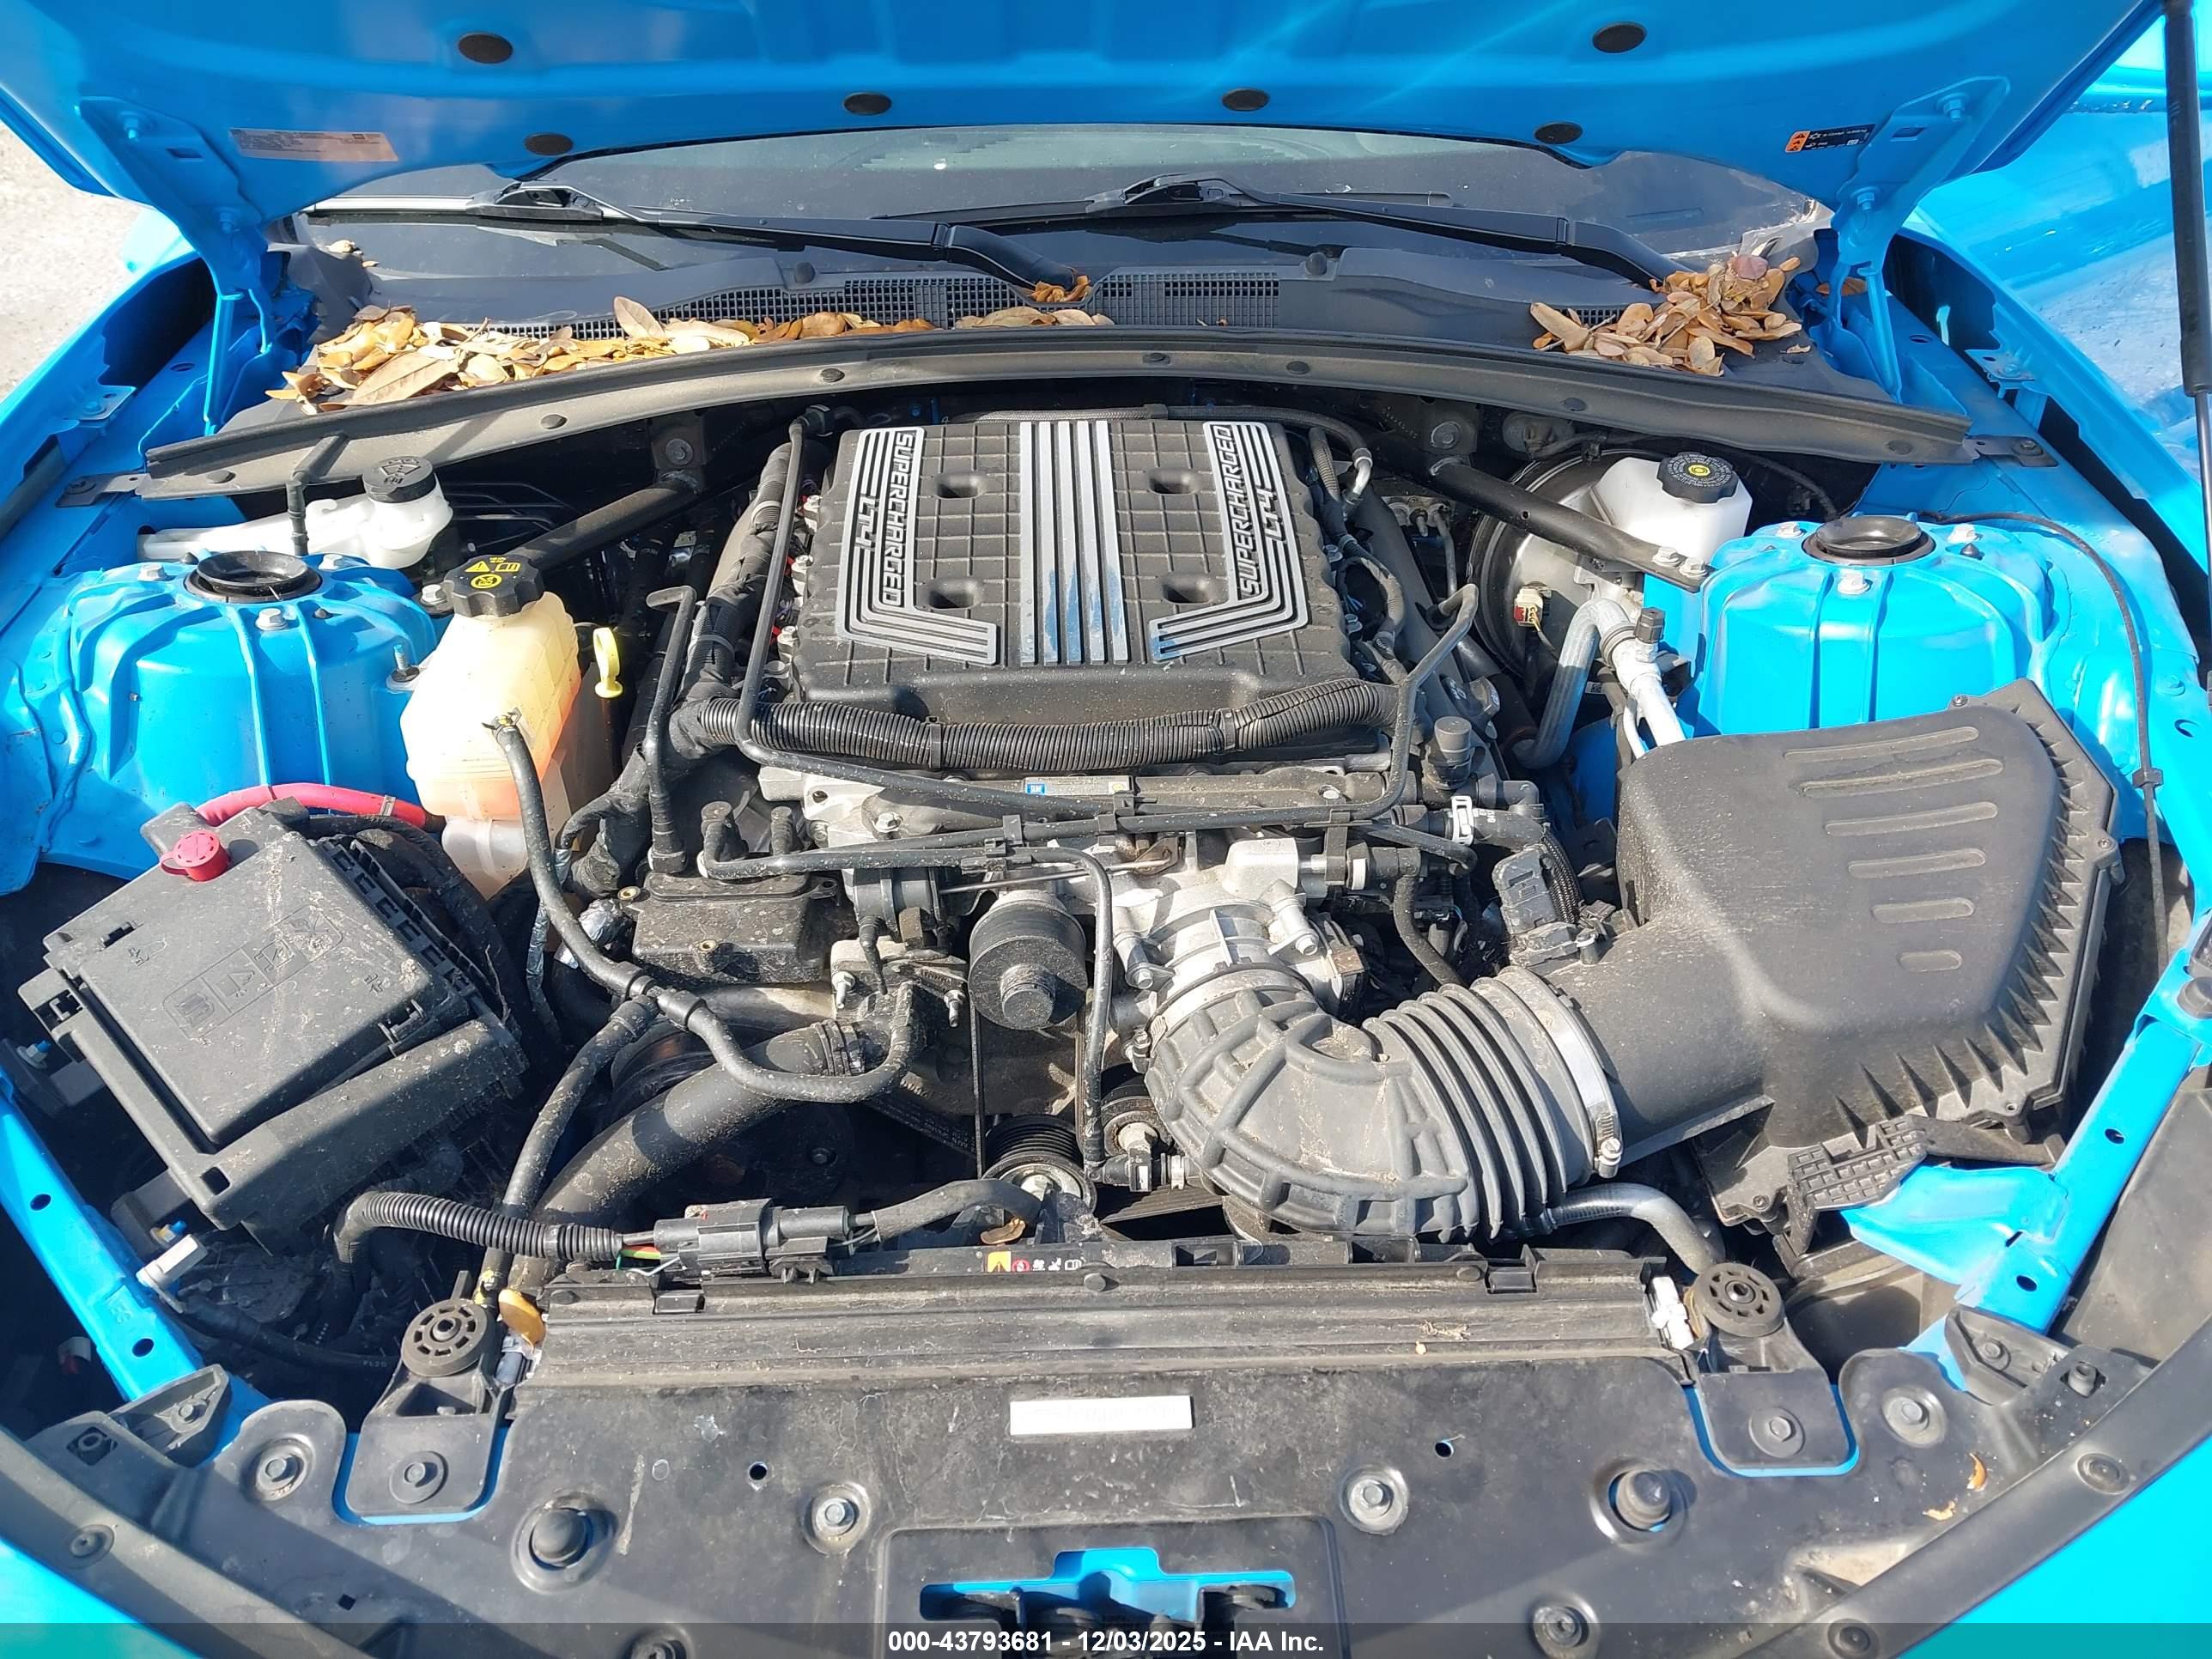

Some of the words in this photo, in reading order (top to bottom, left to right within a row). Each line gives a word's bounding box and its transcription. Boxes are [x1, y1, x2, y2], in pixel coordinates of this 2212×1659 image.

[855, 494, 876, 546] LT4
[882, 432, 914, 606] SUPERCHARGED
[1213, 425, 1260, 595] SUPERCHARGED
[1256, 489, 1282, 541] LT4
